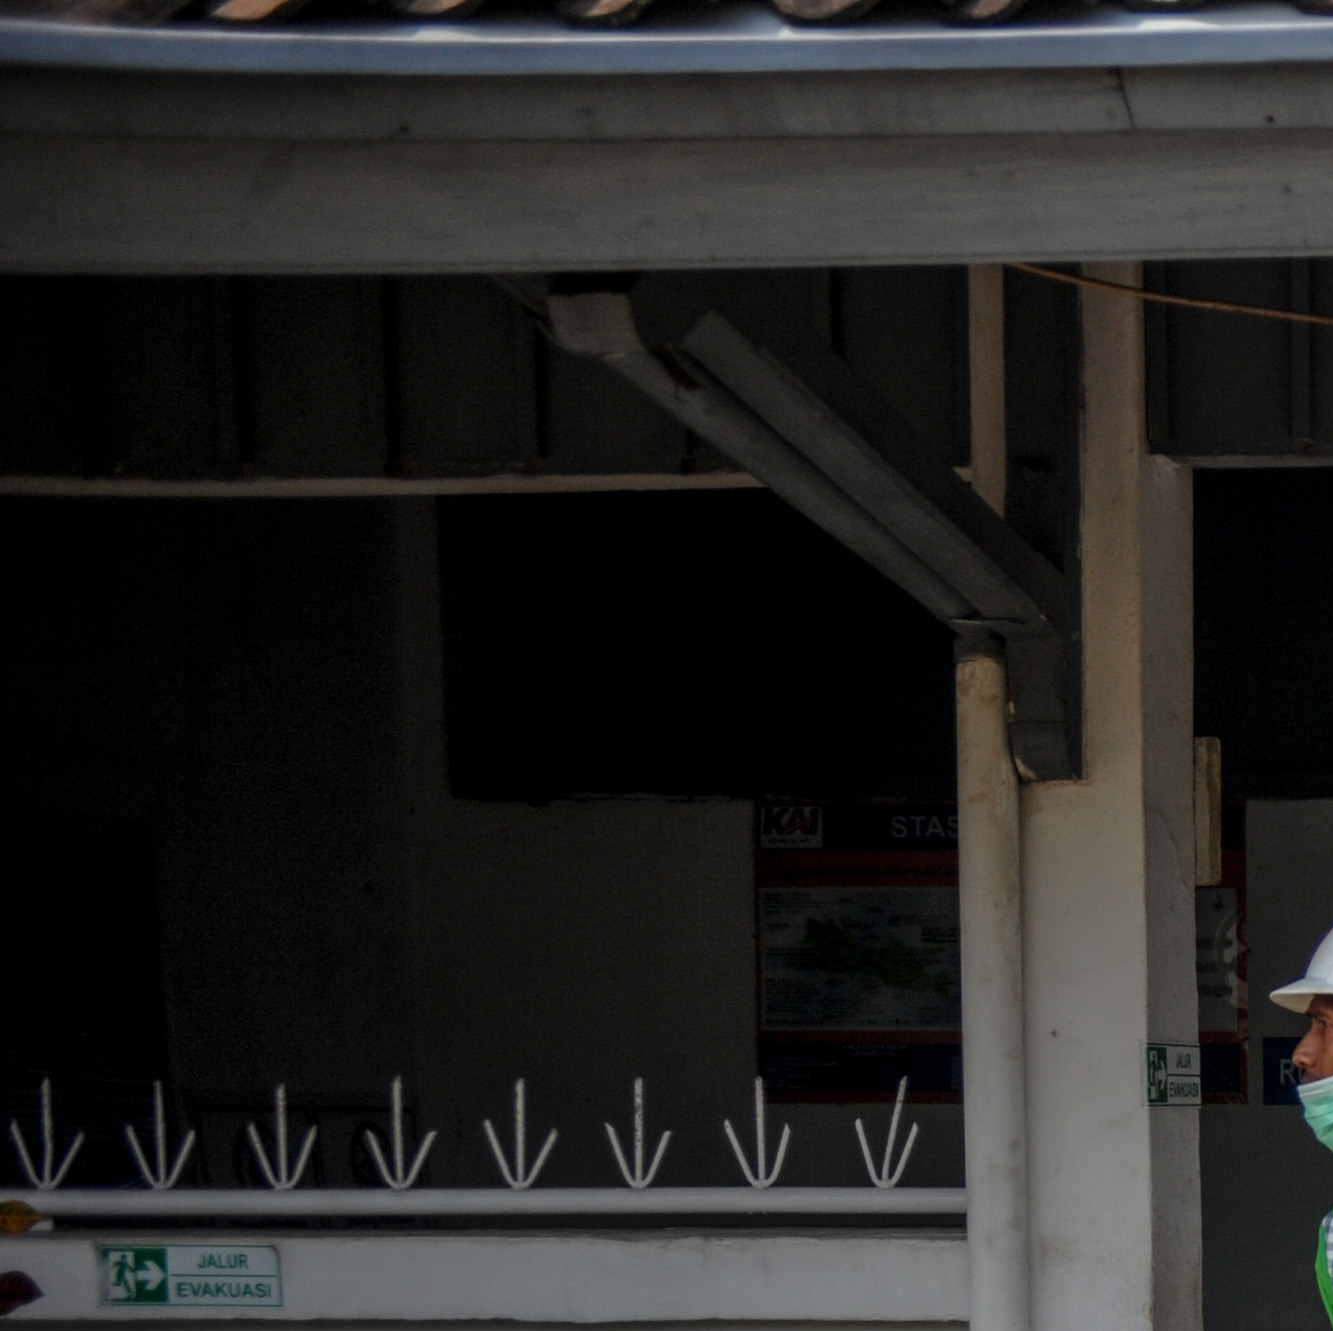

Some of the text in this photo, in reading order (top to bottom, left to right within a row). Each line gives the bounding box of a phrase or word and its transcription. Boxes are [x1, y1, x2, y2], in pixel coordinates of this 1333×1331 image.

[763, 806, 819, 835] KAI
[1169, 1081, 1199, 1099] EVAKUASI
[198, 1254, 248, 1269] JALUR
[176, 1282, 272, 1298] EVAKUASI
